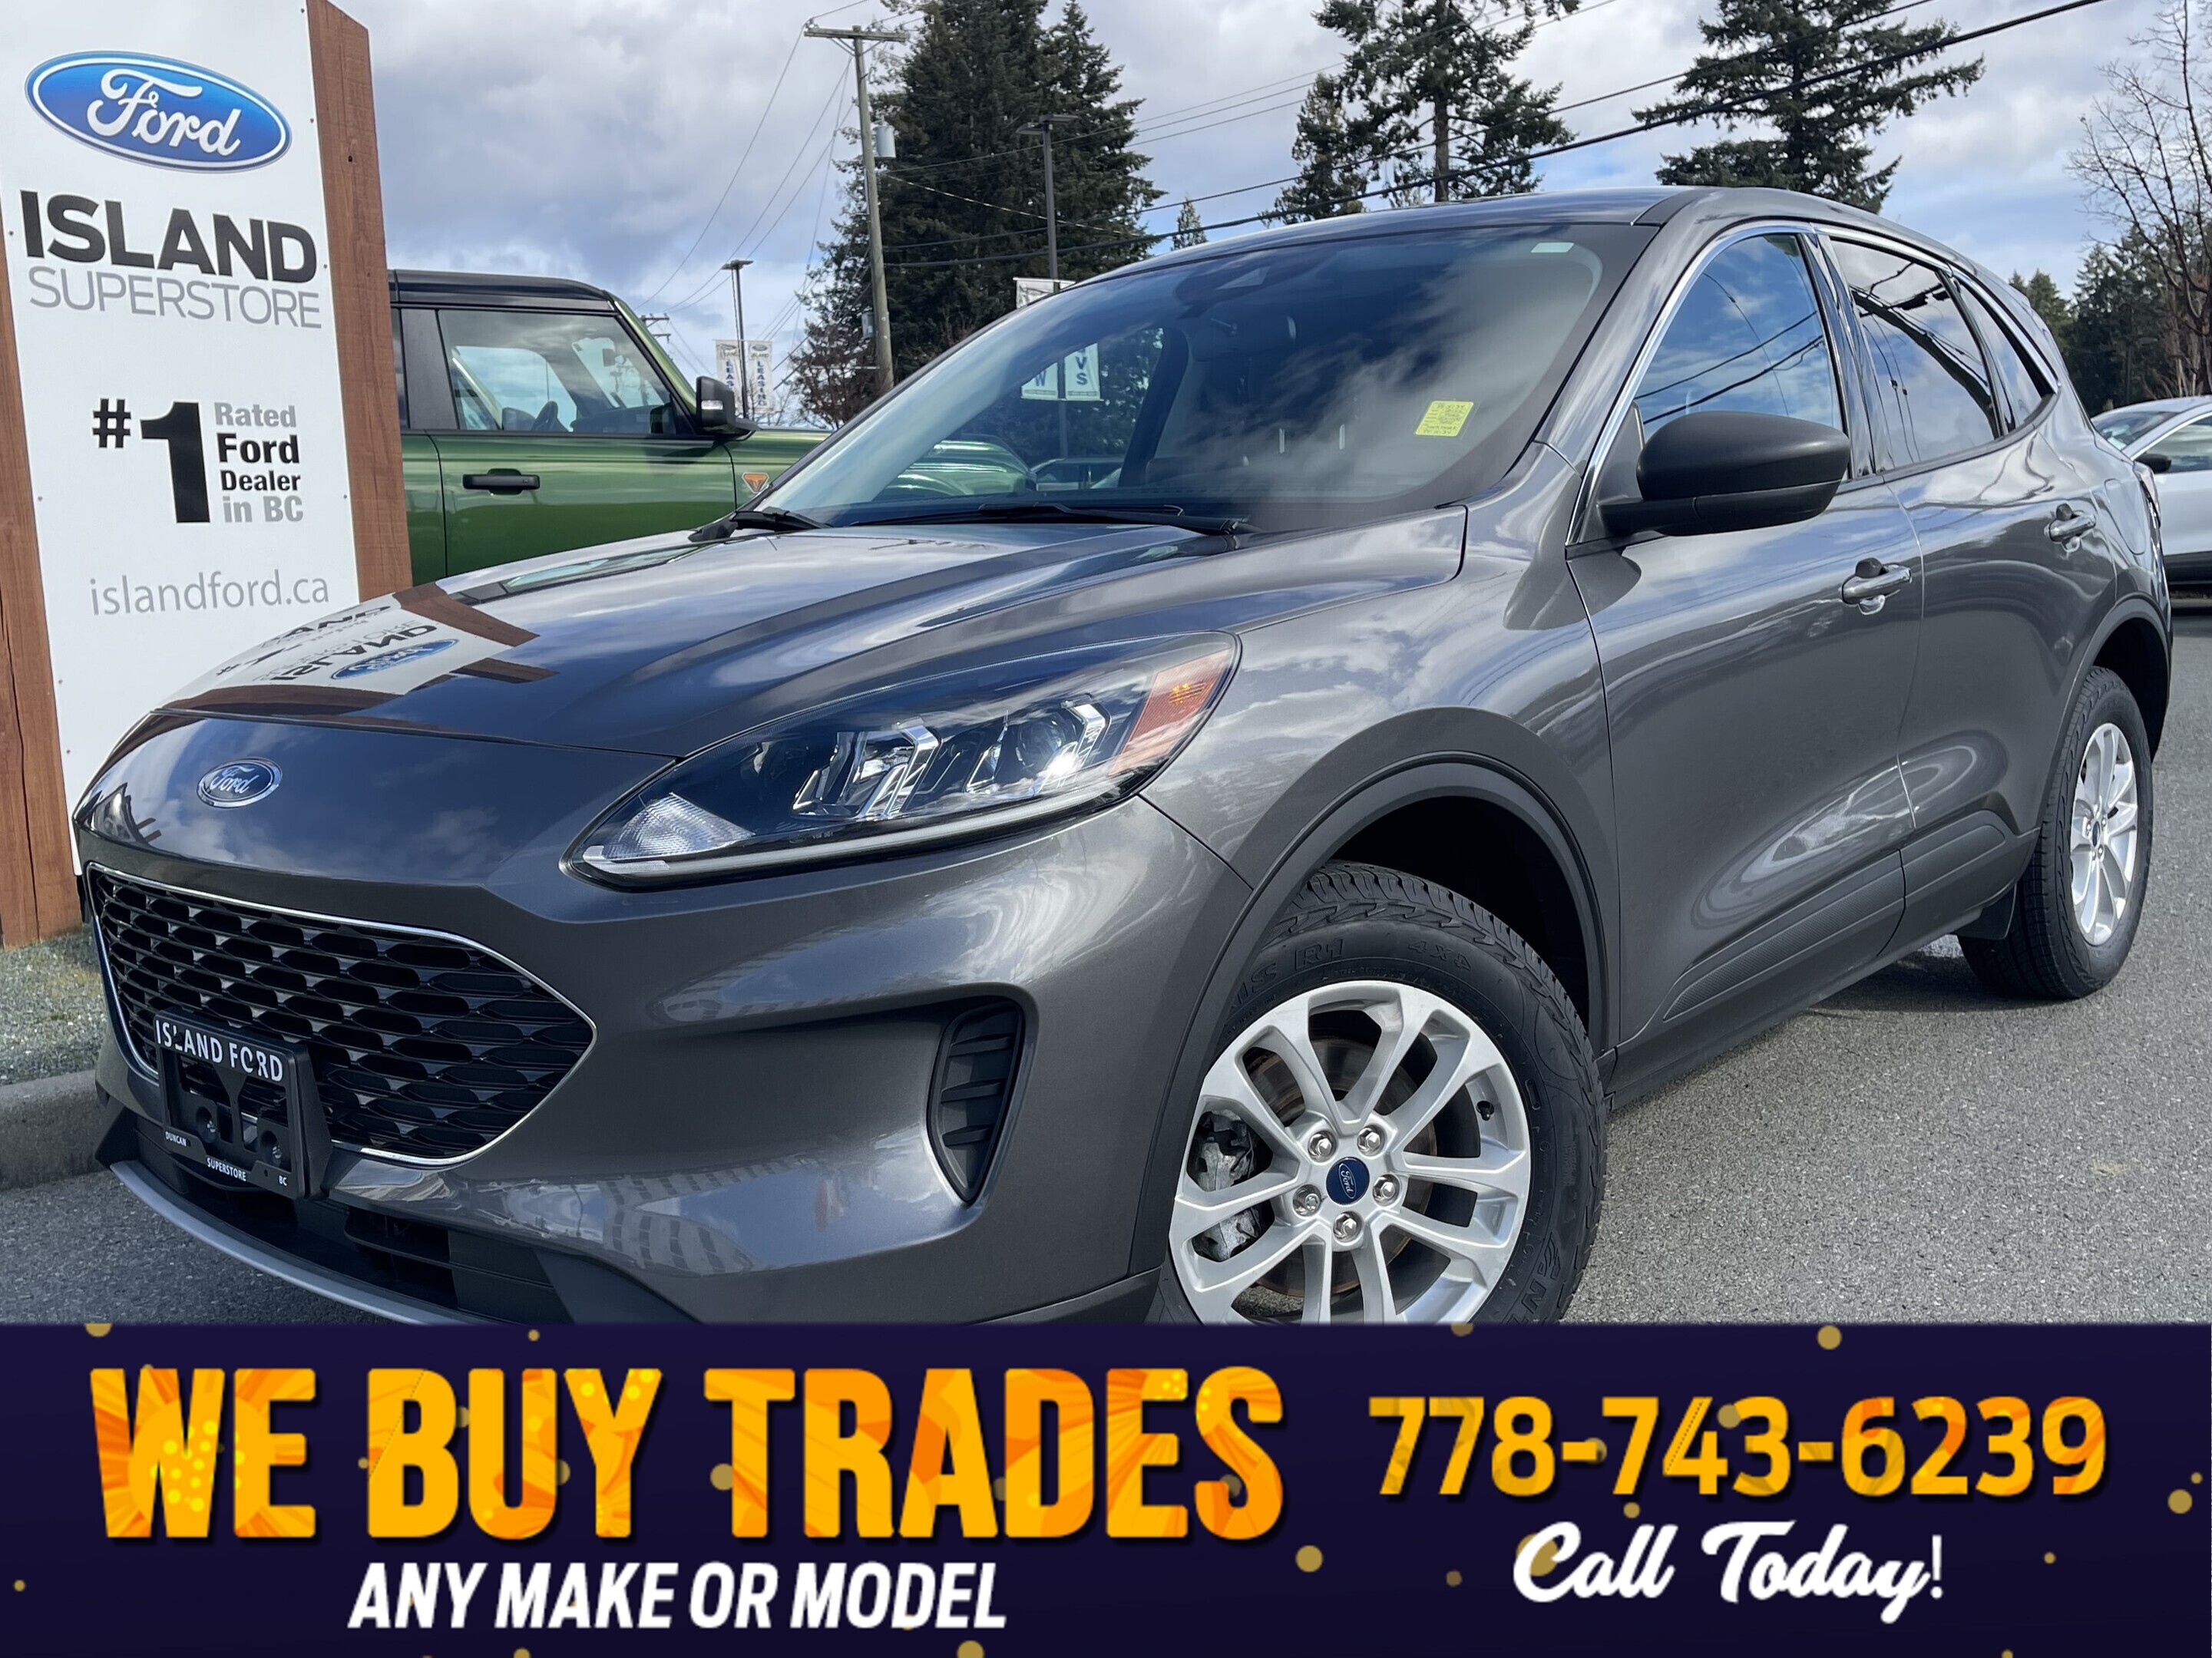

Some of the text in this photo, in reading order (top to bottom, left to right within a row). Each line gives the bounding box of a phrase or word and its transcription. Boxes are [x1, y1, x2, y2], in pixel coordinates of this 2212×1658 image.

[87, 68, 242, 157] Ford
[20, 190, 318, 283] ISLAND
[28, 266, 322, 329] SUPERSTORE
[756, 360, 767, 407] LEASING
[214, 401, 297, 428] Rated
[92, 398, 211, 523] #1
[216, 433, 300, 464] Ford
[220, 469, 302, 492] Dealer
[223, 495, 304, 523] in BC
[89, 569, 330, 616] islandford.ca
[209, 765, 260, 794] Ford
[155, 1019, 283, 1082] ISLAND FORD
[165, 1131, 187, 1148] DUNCAN
[207, 1157, 247, 1182] SUPERSTORE
[279, 1174, 288, 1187] BC
[1340, 1170, 1354, 1194] Ford
